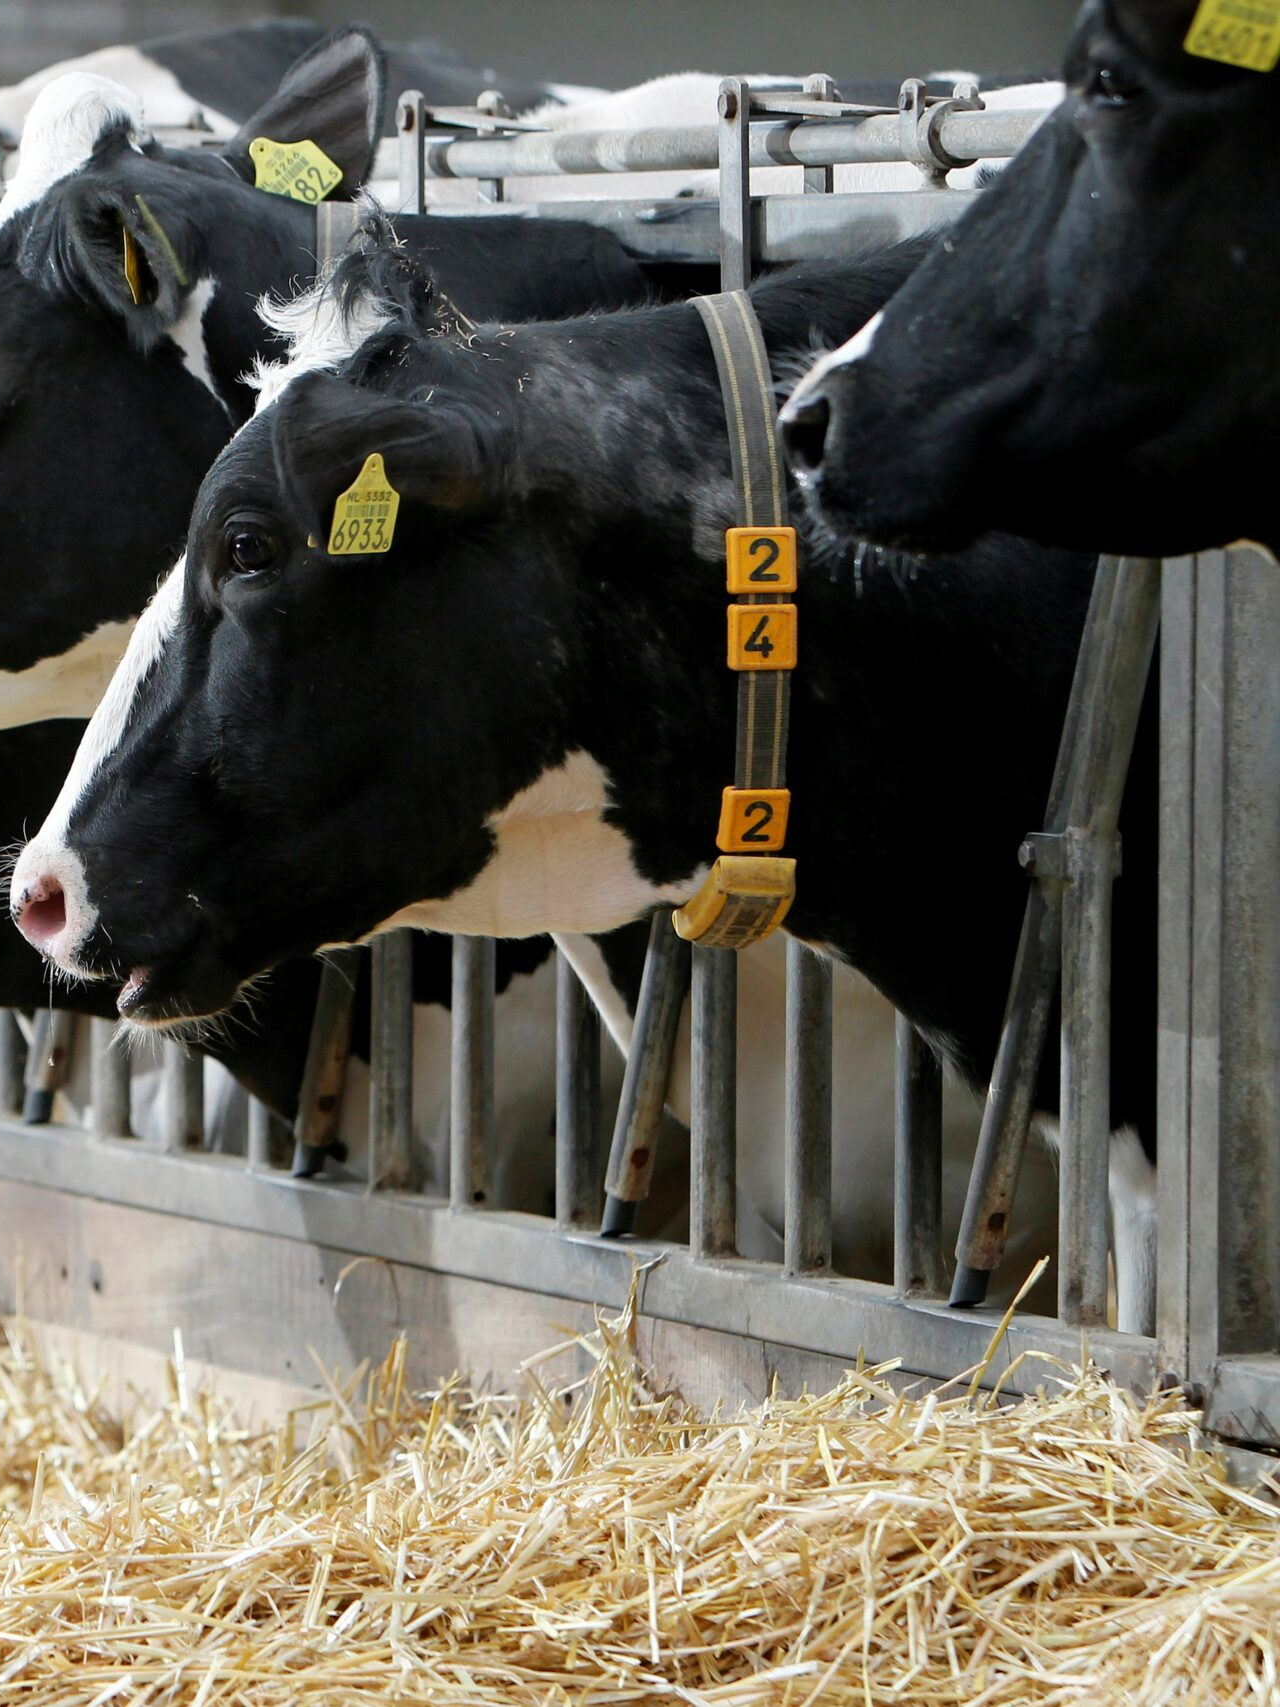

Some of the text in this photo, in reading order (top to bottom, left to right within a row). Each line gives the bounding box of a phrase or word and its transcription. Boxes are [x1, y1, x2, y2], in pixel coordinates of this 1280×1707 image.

[287, 166, 333, 202] 82
[332, 518, 386, 551] 6933
[749, 538, 780, 582] 2
[744, 615, 774, 658] 4
[741, 801, 773, 842] 2
